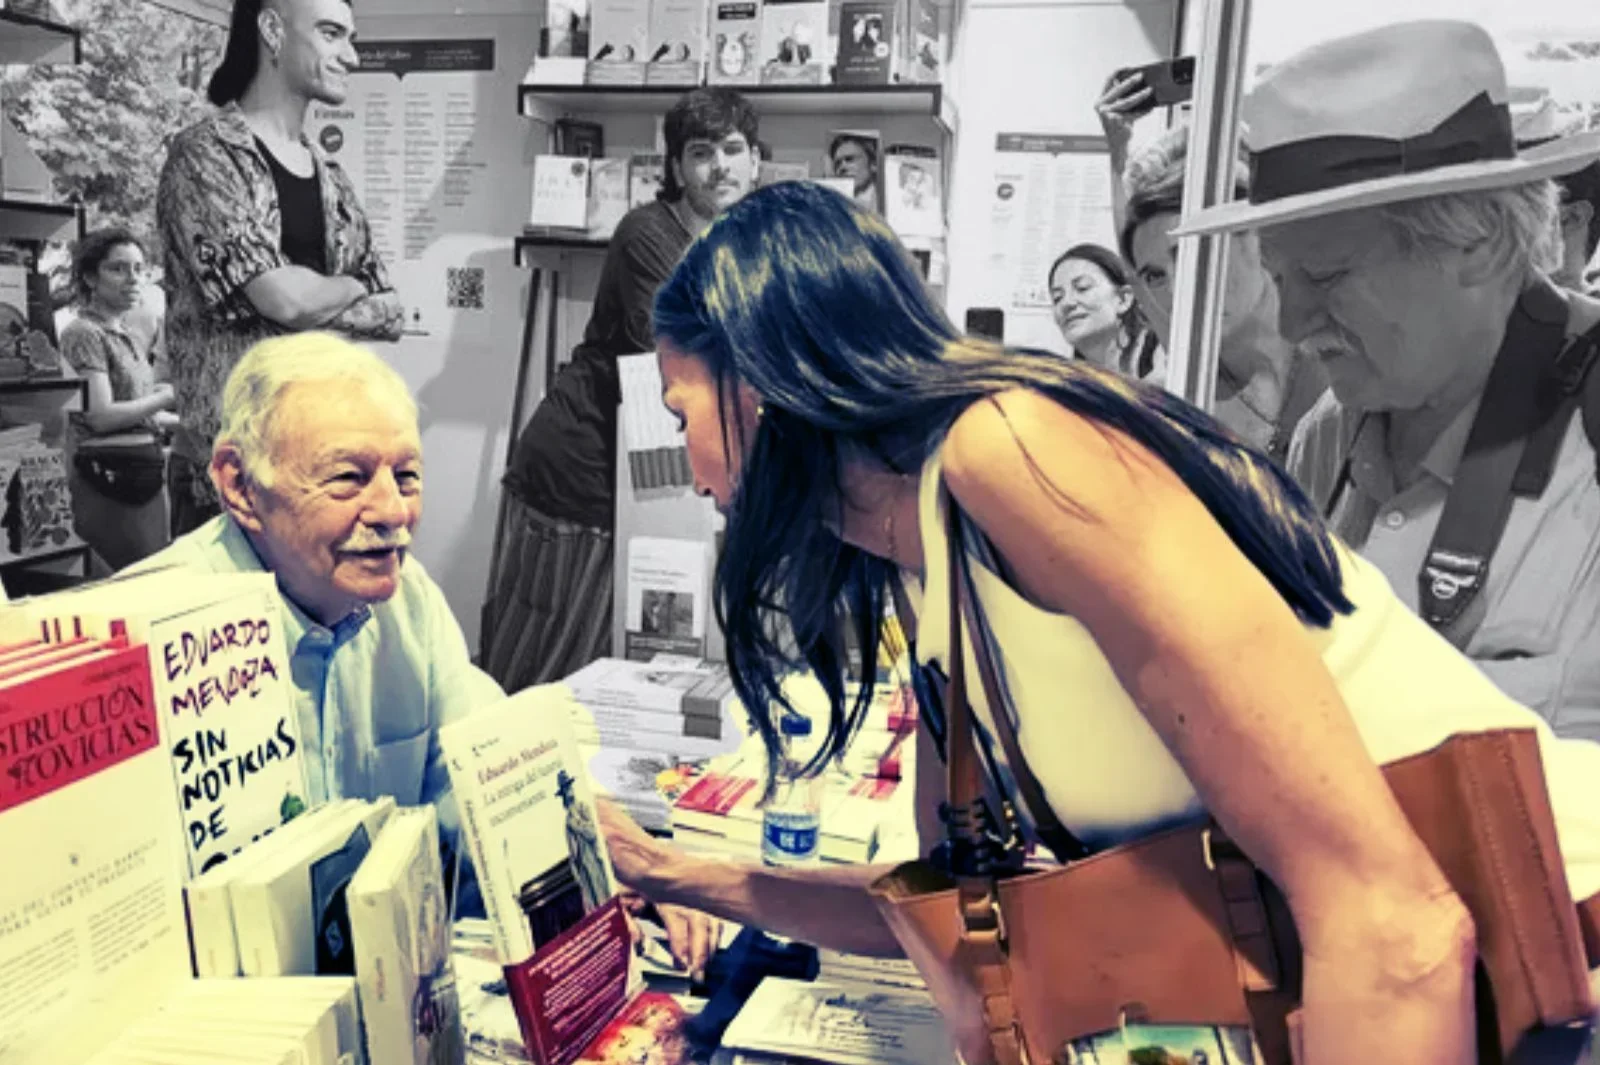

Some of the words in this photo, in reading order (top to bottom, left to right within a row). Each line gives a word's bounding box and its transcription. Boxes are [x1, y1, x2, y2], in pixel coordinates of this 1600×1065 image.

[163, 619, 271, 682] EDUARDO
[170, 655, 279, 717] MENDOZA
[172, 728, 227, 773] SIN
[181, 717, 297, 810] NOTICIAS
[189, 804, 228, 851] DE
